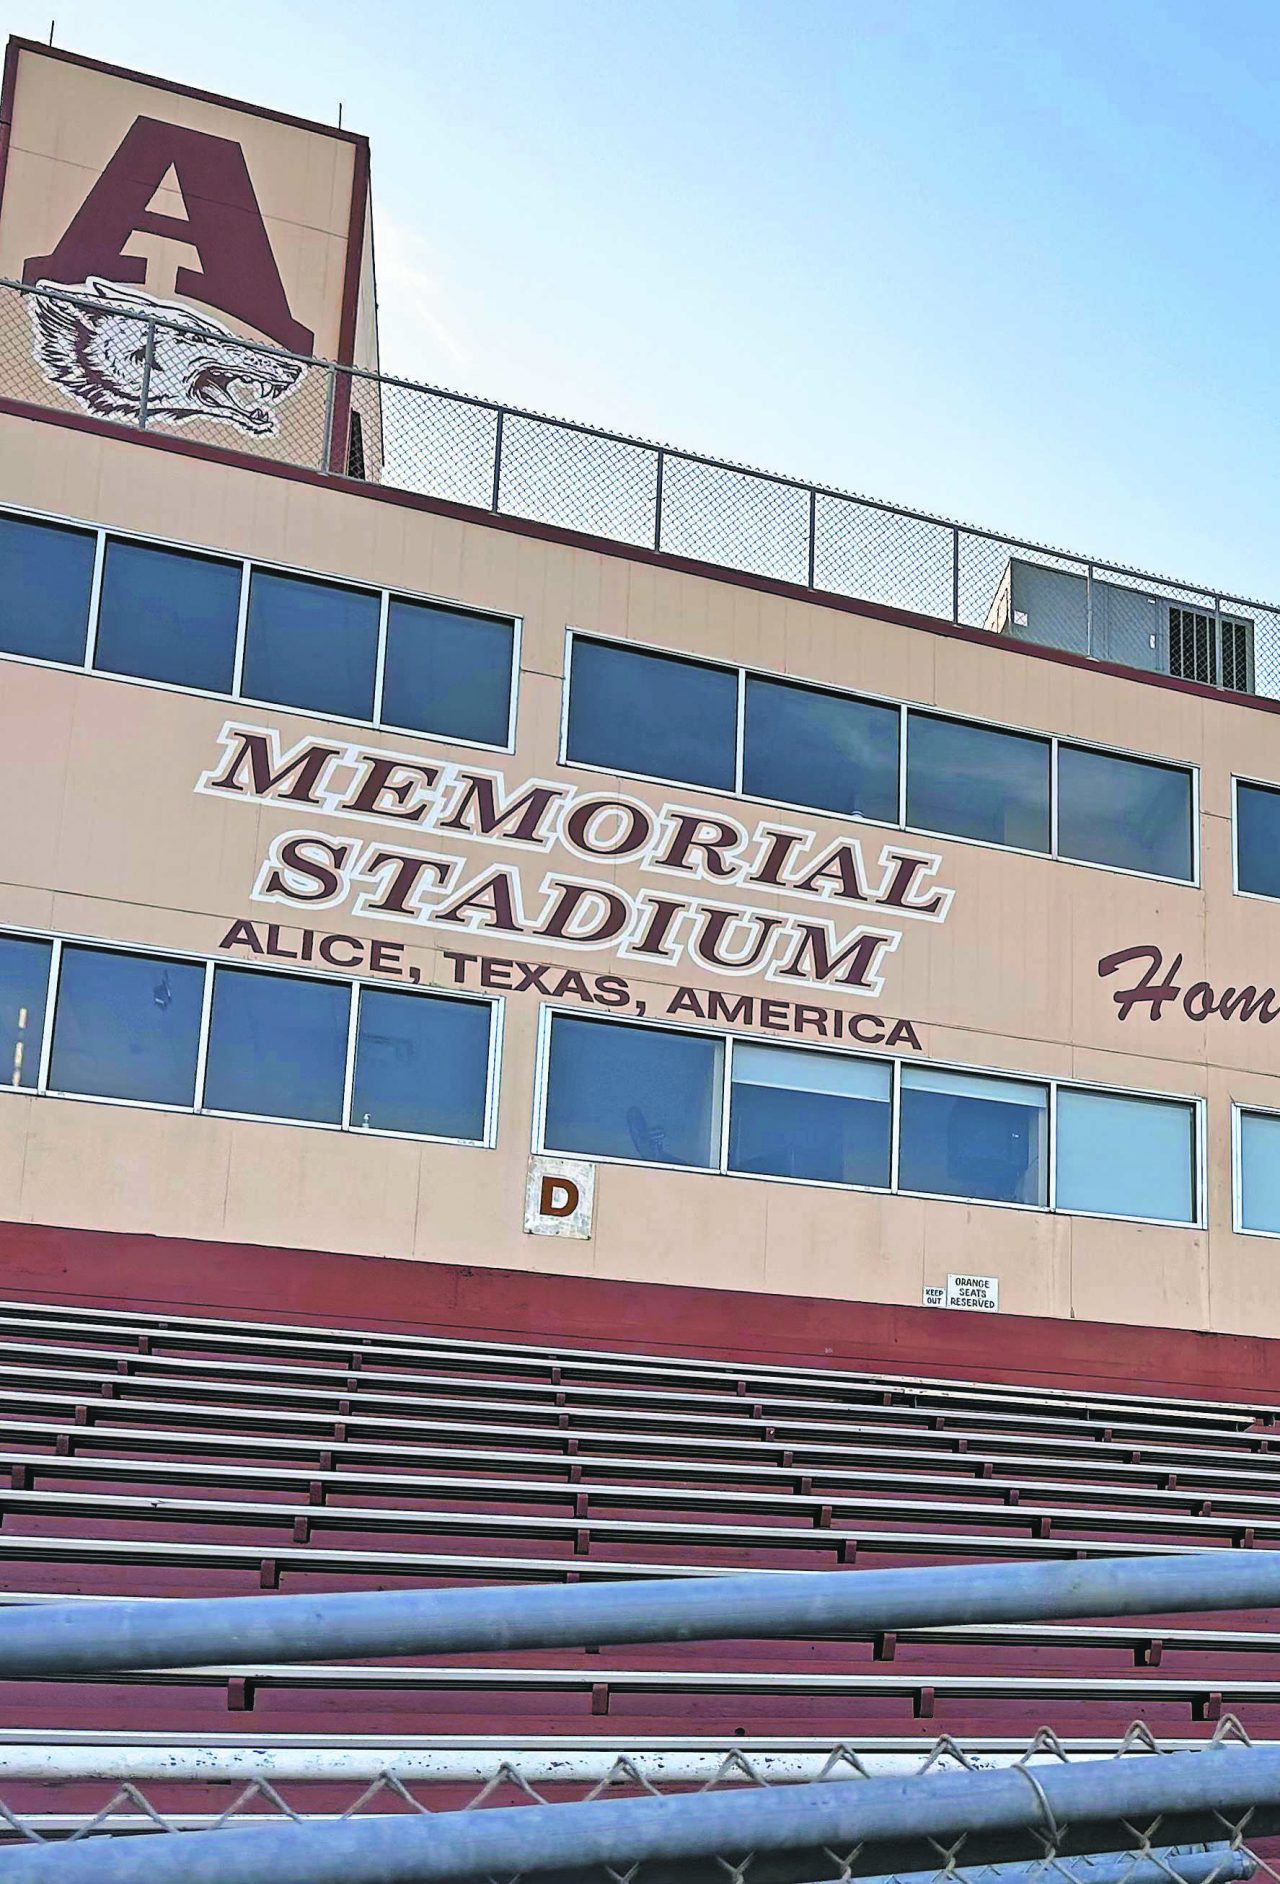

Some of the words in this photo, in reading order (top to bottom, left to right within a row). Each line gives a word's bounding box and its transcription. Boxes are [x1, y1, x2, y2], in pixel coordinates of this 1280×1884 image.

[23, 115, 314, 356] A
[194, 720, 956, 922] MEMORIAL
[250, 829, 902, 997] STADIUM
[219, 919, 422, 984] ALICE,
[444, 952, 647, 1017] TEXAS,
[667, 987, 923, 1050] AMERICA
[540, 1176, 579, 1217] D
[925, 1289, 944, 1297] KEEP
[951, 1297, 995, 1309] RESERVED
[955, 1277, 990, 1288] ORANGE
[959, 1288, 986, 1298] SEATS
